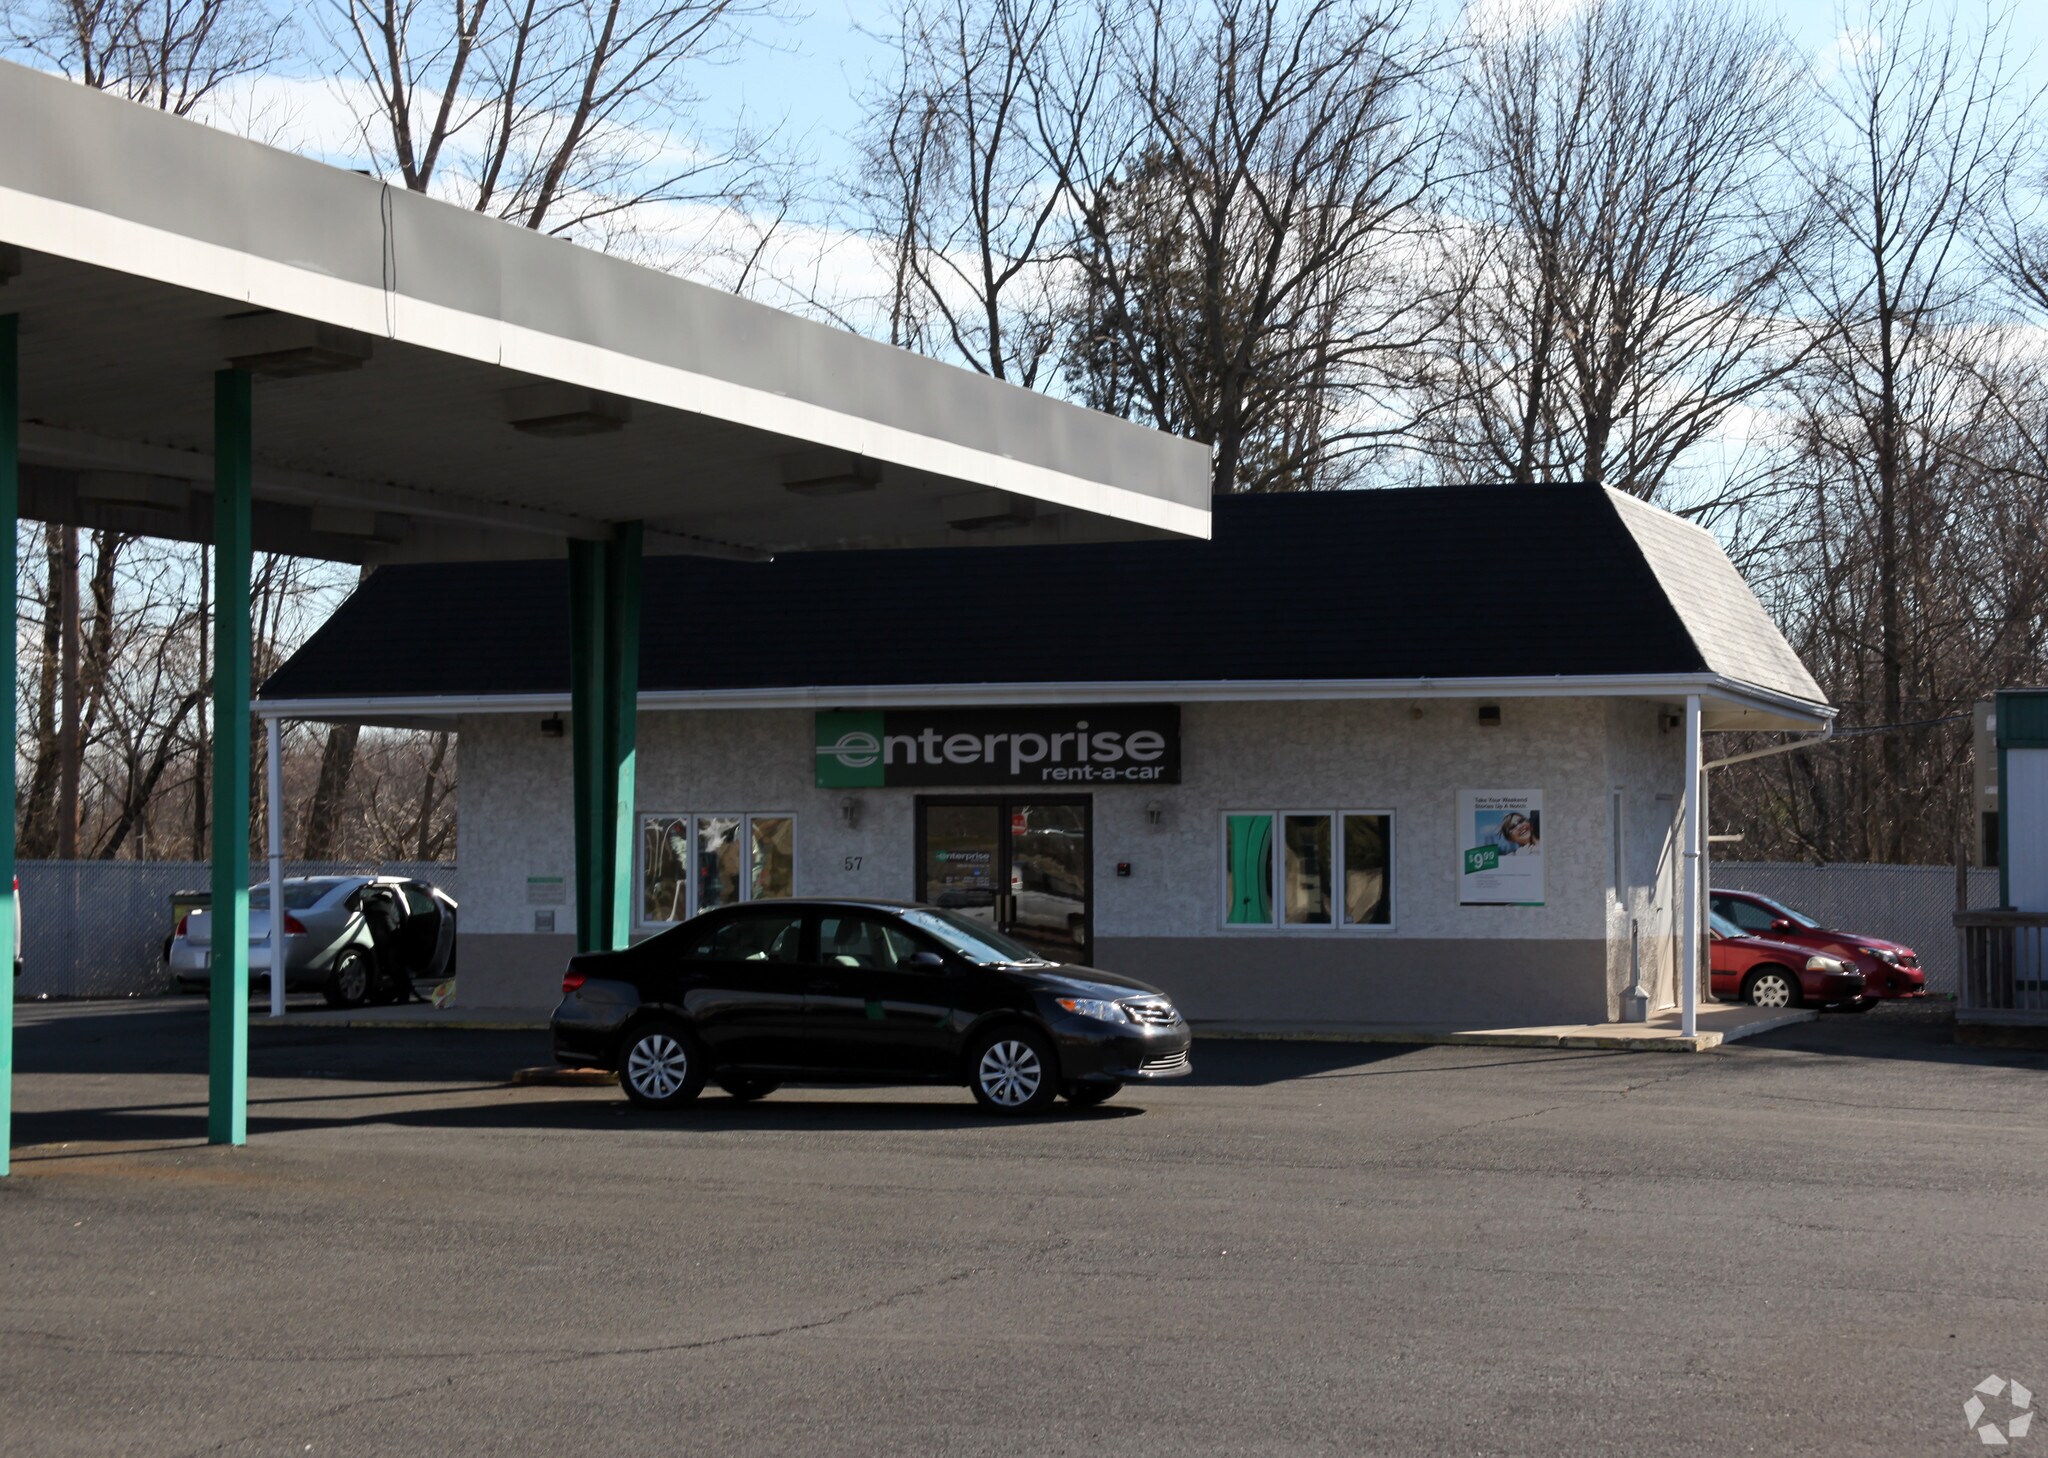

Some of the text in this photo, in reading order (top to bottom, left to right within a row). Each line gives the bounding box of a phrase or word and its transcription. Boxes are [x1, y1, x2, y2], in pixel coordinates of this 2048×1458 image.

[816, 720, 1166, 774] enterprise
[1042, 765, 1165, 781] rent-a-car
[844, 856, 863, 871] 57
[936, 851, 990, 861] enterprise
